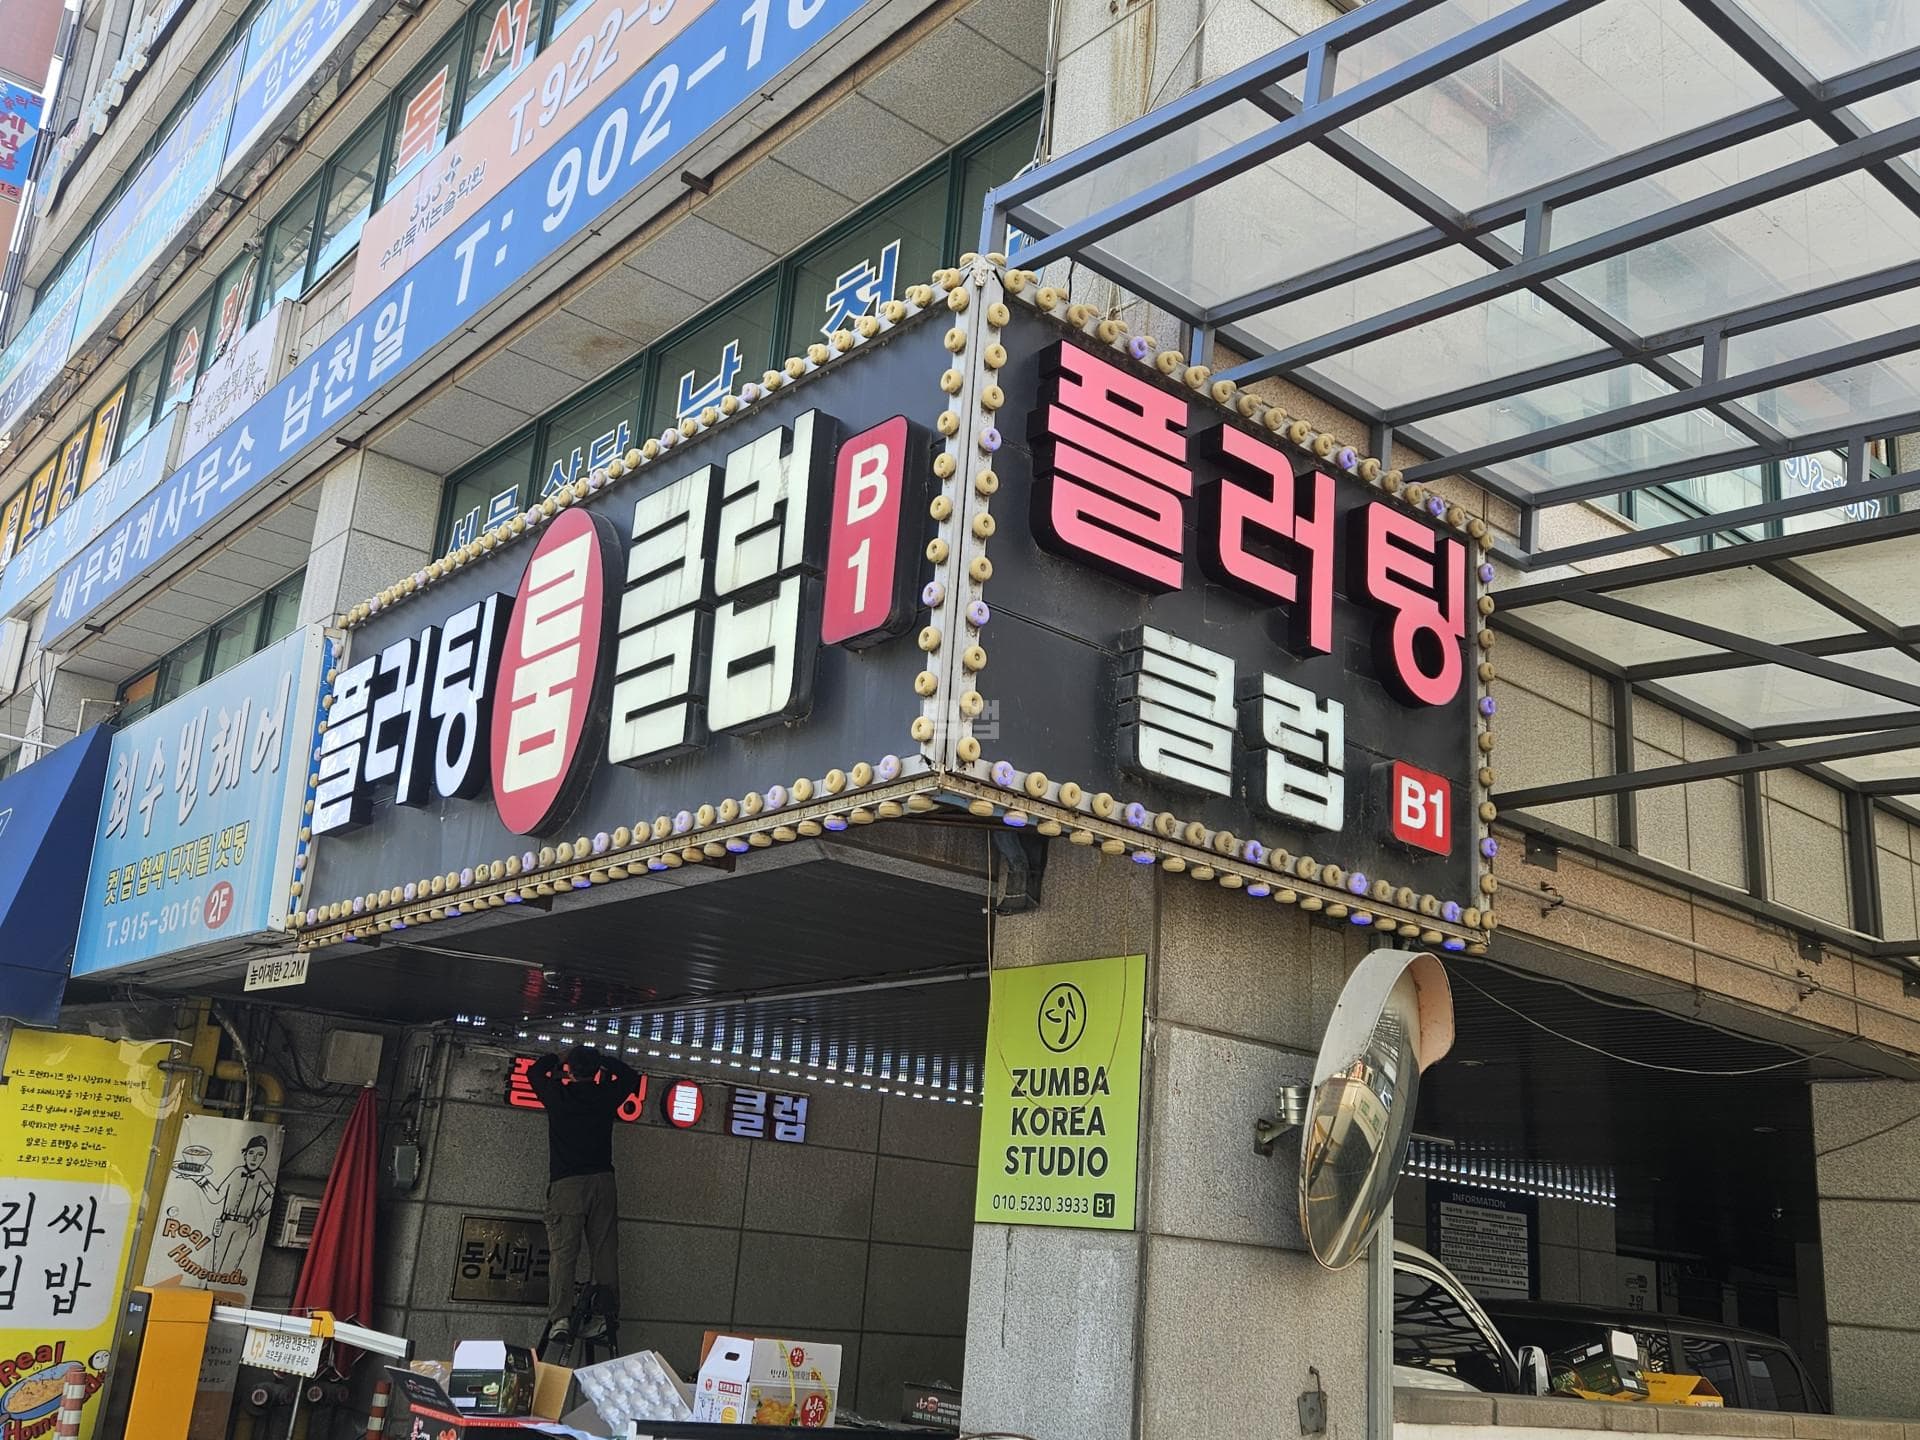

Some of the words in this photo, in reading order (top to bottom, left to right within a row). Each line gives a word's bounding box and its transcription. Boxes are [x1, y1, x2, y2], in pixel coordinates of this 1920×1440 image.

[55, 432, 256, 619] 세무회계사무소
[279, 280, 412, 453] 남천일
[1048, 339, 1466, 706] 플러팅
[312, 592, 498, 836] 플러팅
[502, 531, 592, 793] 룸
[608, 407, 816, 765] 클럽
[1136, 624, 1346, 833] 클럽
[1400, 775, 1444, 838] B1
[106, 896, 200, 948] T.915-3016
[208, 888, 229, 924] 2F
[249, 961, 282, 985] 높이제한
[1011, 1066, 1110, 1097] ZUMBA
[673, 1085, 698, 1122] 룸
[731, 1087, 809, 1144] 클럽
[1011, 1106, 1106, 1136] KOREA
[1004, 1145, 1109, 1178] STUDIO
[992, 1194, 1089, 1214] 010.5230.3933
[1096, 1197, 1114, 1215] B1
[1452, 1193, 1507, 1209] INFORMATION
[163, 1218, 212, 1251] Real
[168, 1243, 248, 1286] Homemade
[0, 1340, 65, 1388] Real
